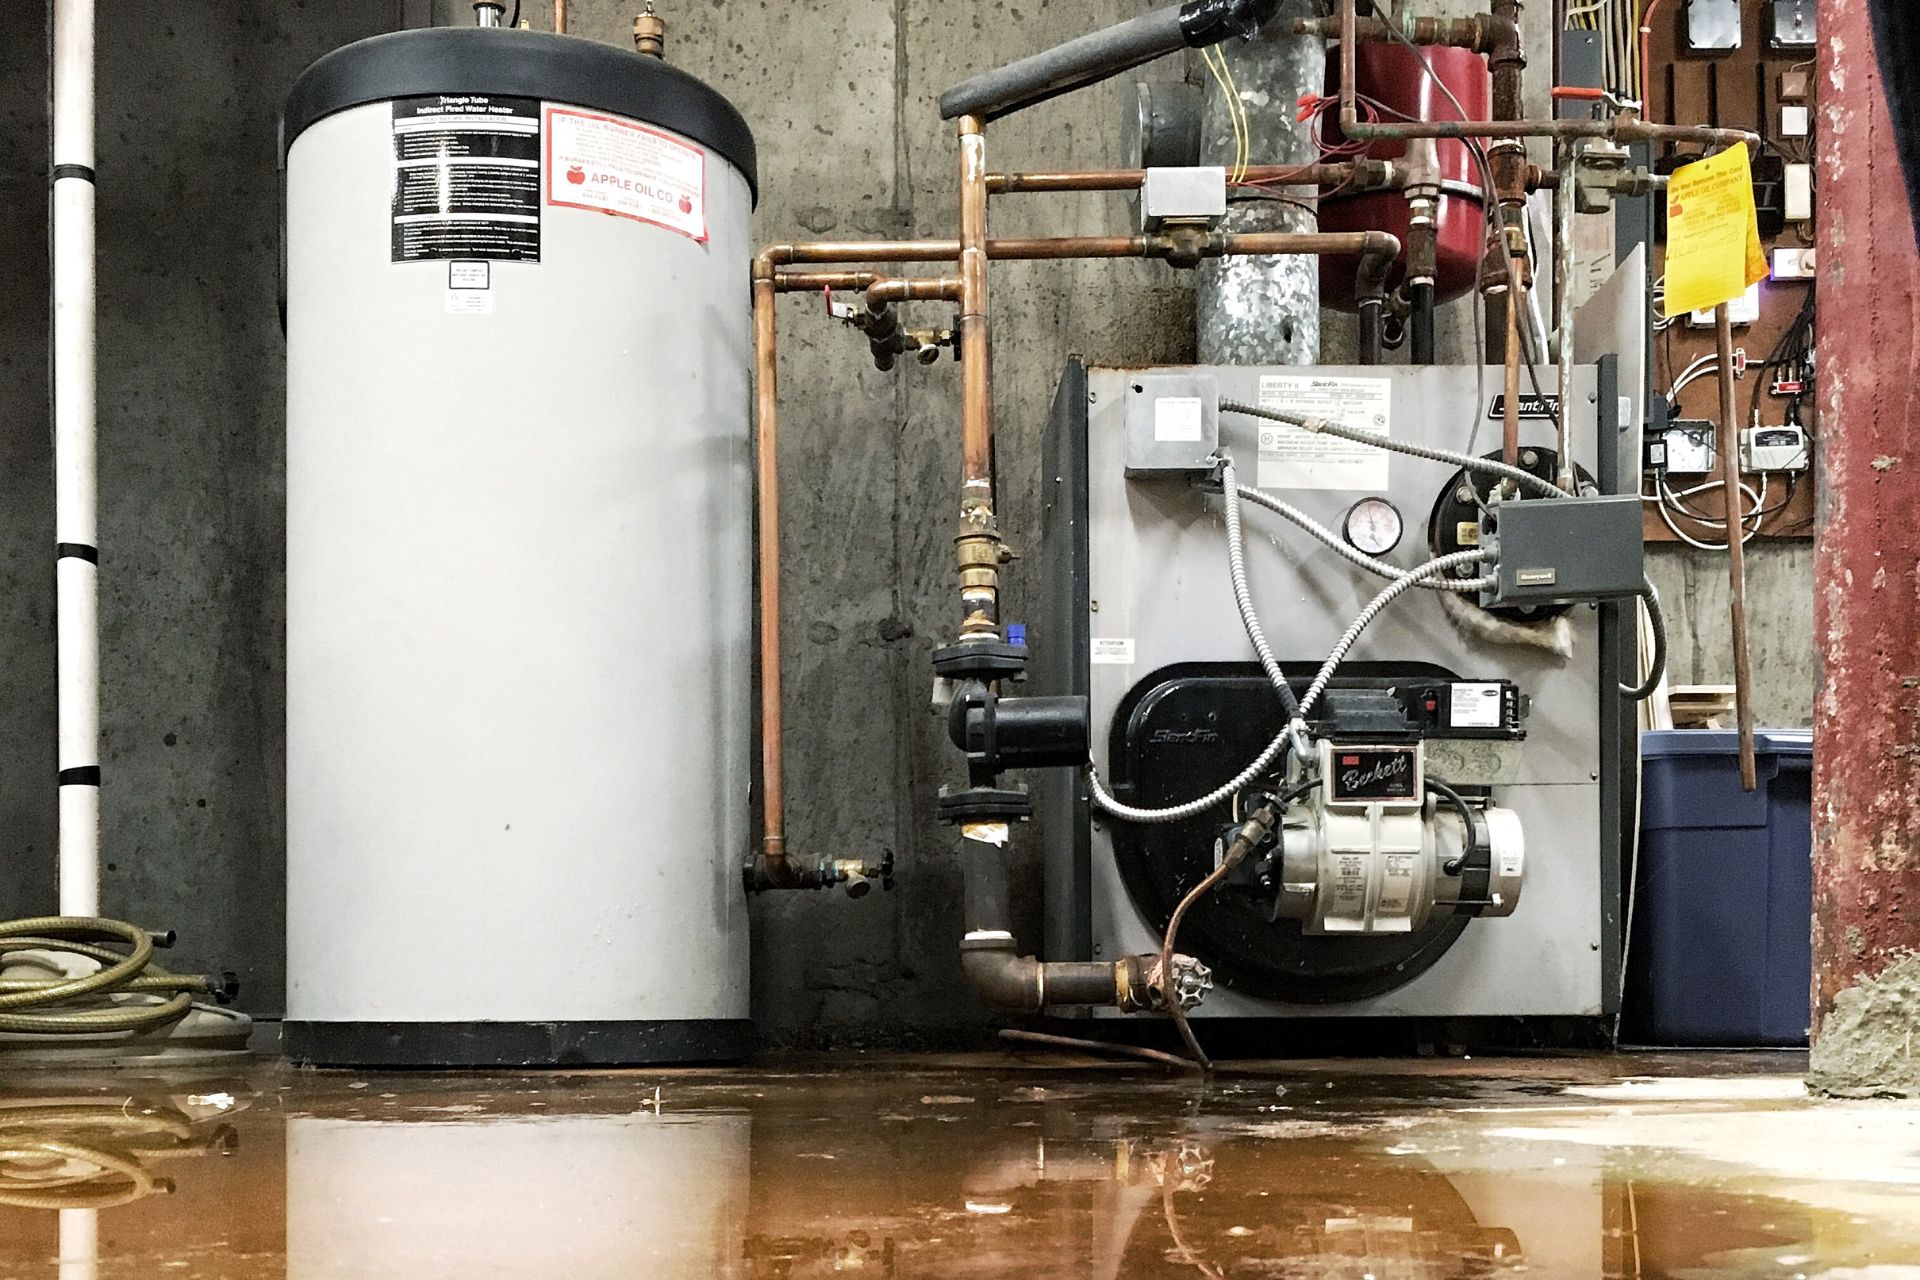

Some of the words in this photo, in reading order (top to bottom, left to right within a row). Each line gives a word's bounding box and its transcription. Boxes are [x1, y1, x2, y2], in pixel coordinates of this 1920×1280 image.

[440, 96, 469, 105] Triangle
[488, 106, 513, 114] Heater
[569, 118, 585, 126] THE
[588, 121, 601, 130] OIL
[604, 124, 636, 138] BURNER
[637, 132, 657, 145] FAILS
[591, 173, 632, 191] APPLE
[634, 182, 655, 198] OIL
[1342, 755, 1407, 792] Beckett
